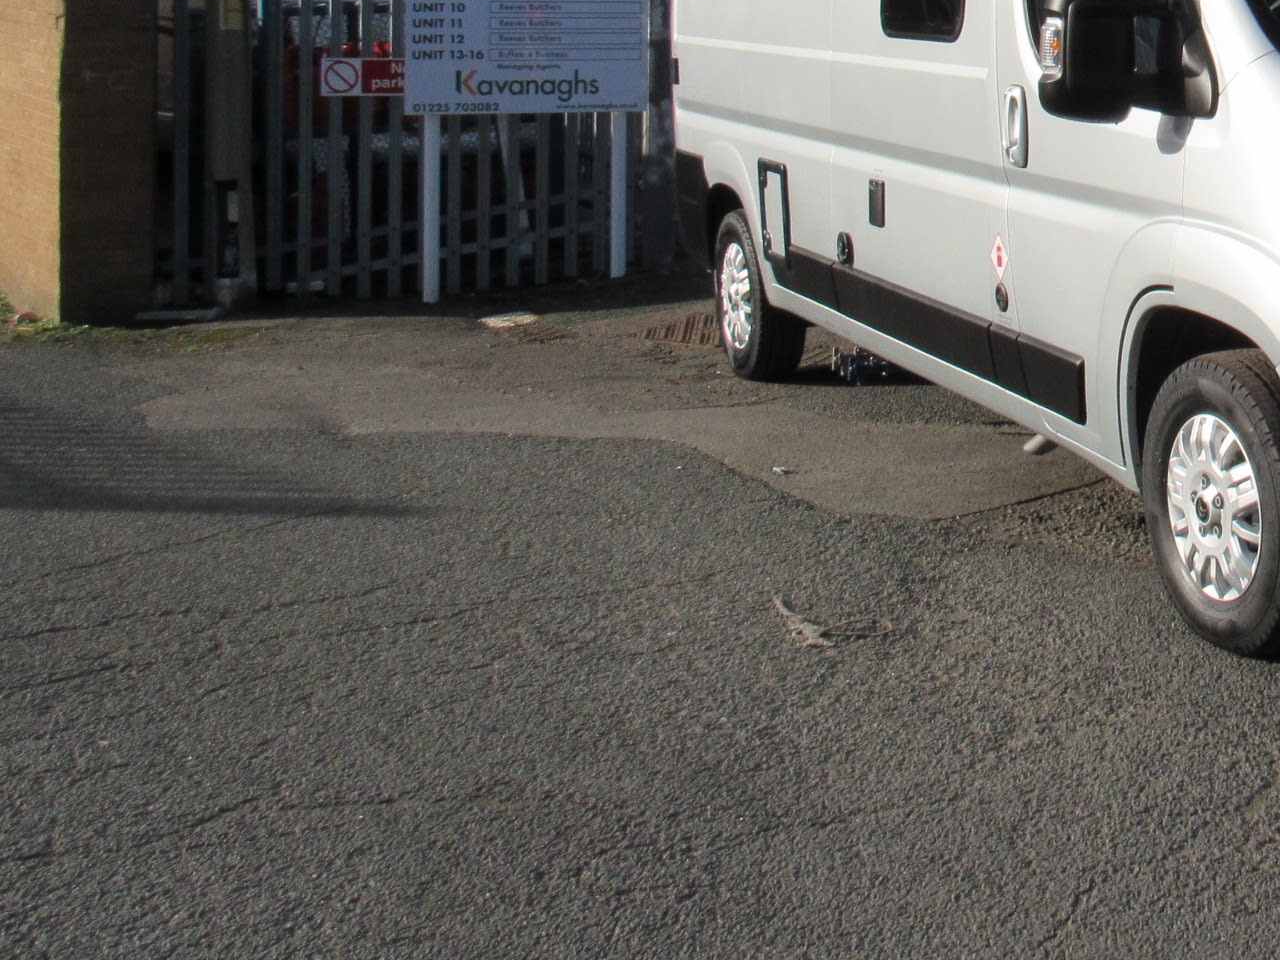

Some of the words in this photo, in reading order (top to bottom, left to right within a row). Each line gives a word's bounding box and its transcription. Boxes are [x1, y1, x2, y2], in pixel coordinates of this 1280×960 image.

[413, 3, 445, 13] UNIT
[450, 3, 465, 13] 10
[413, 19, 445, 28] UNIT
[450, 19, 462, 29] 11
[412, 34, 444, 44] UNIT
[450, 34, 464, 44] 12
[412, 50, 445, 60] UNIT
[450, 50, 484, 60] 13-16
[455, 69, 599, 101] Kavanaghs
[412, 103, 449, 113] 01225
[453, 102, 500, 112] 703082
